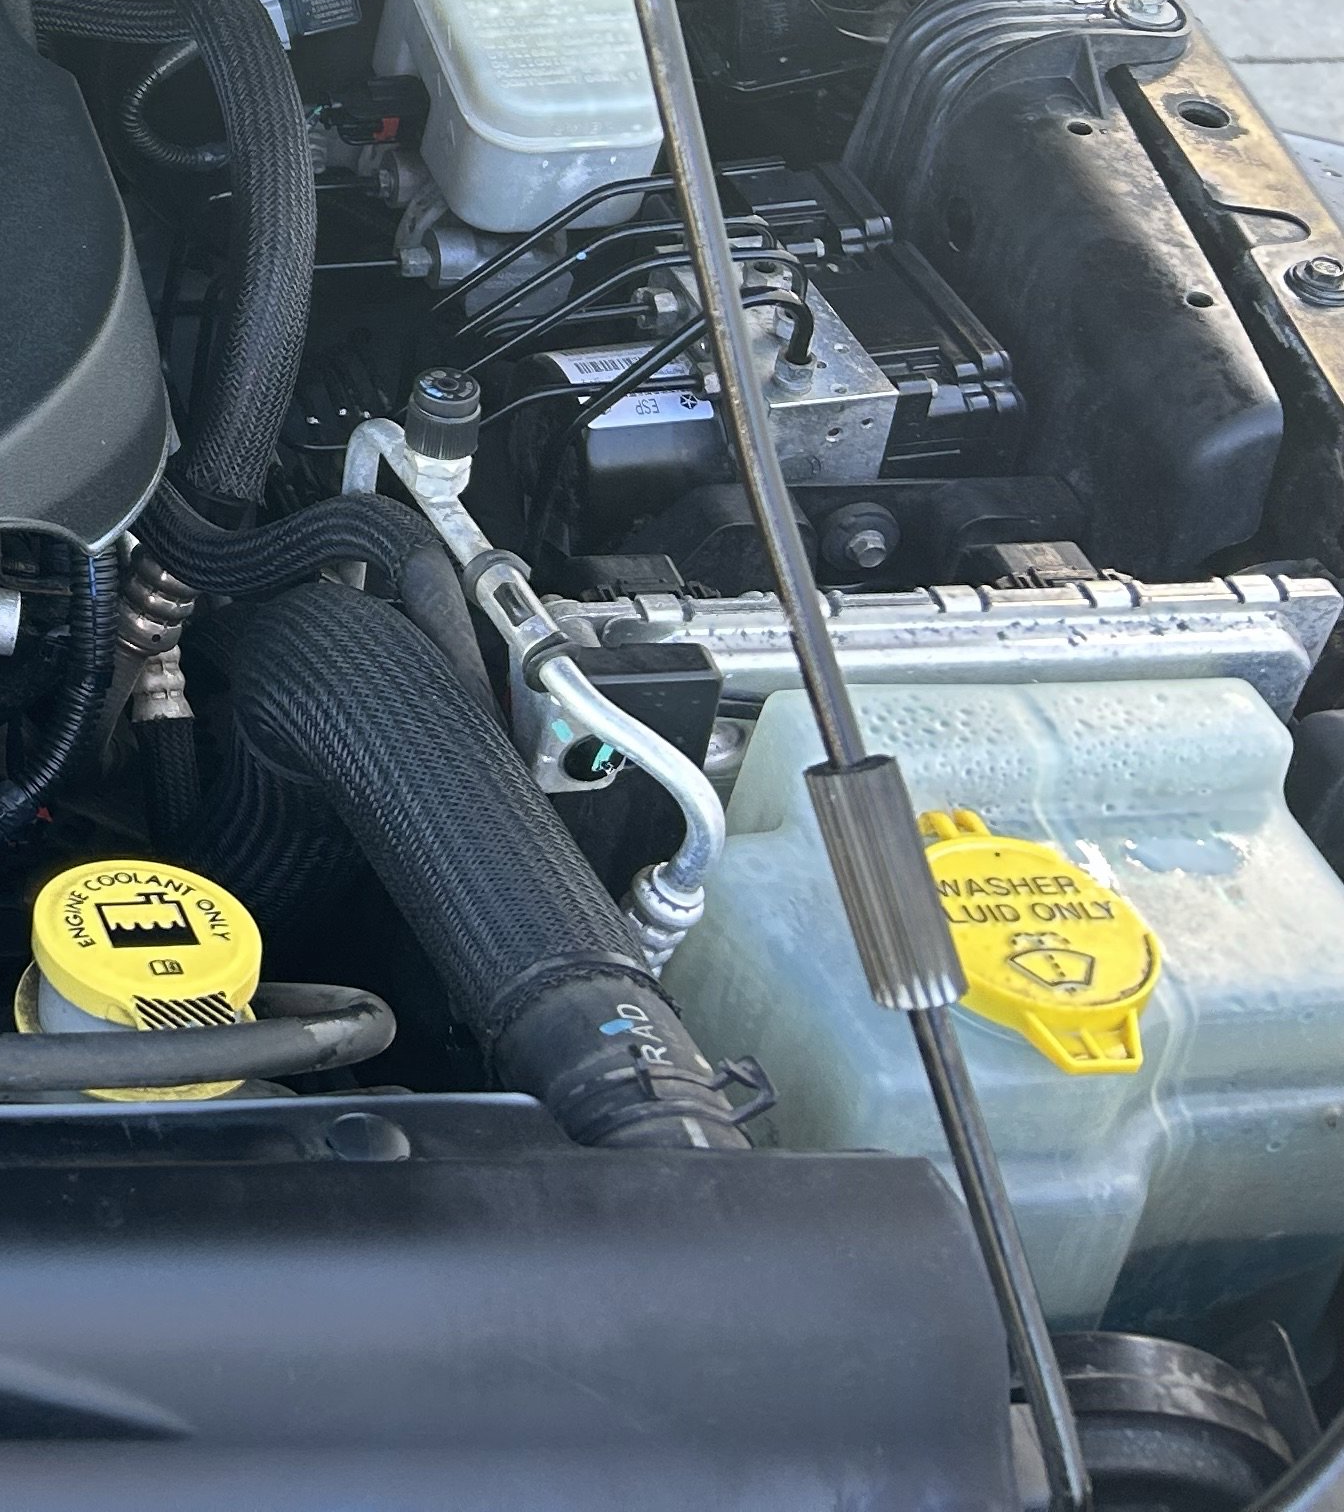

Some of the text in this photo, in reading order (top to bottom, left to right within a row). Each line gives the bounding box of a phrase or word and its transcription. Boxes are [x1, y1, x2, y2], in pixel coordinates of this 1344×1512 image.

[635, 398, 660, 415] ESP
[937, 875, 1081, 898] WASHER
[64, 872, 231, 948] ENGINE COOLANT ONLY
[941, 900, 1115, 924] LUID ONLY
[616, 1003, 673, 1065] RAD
